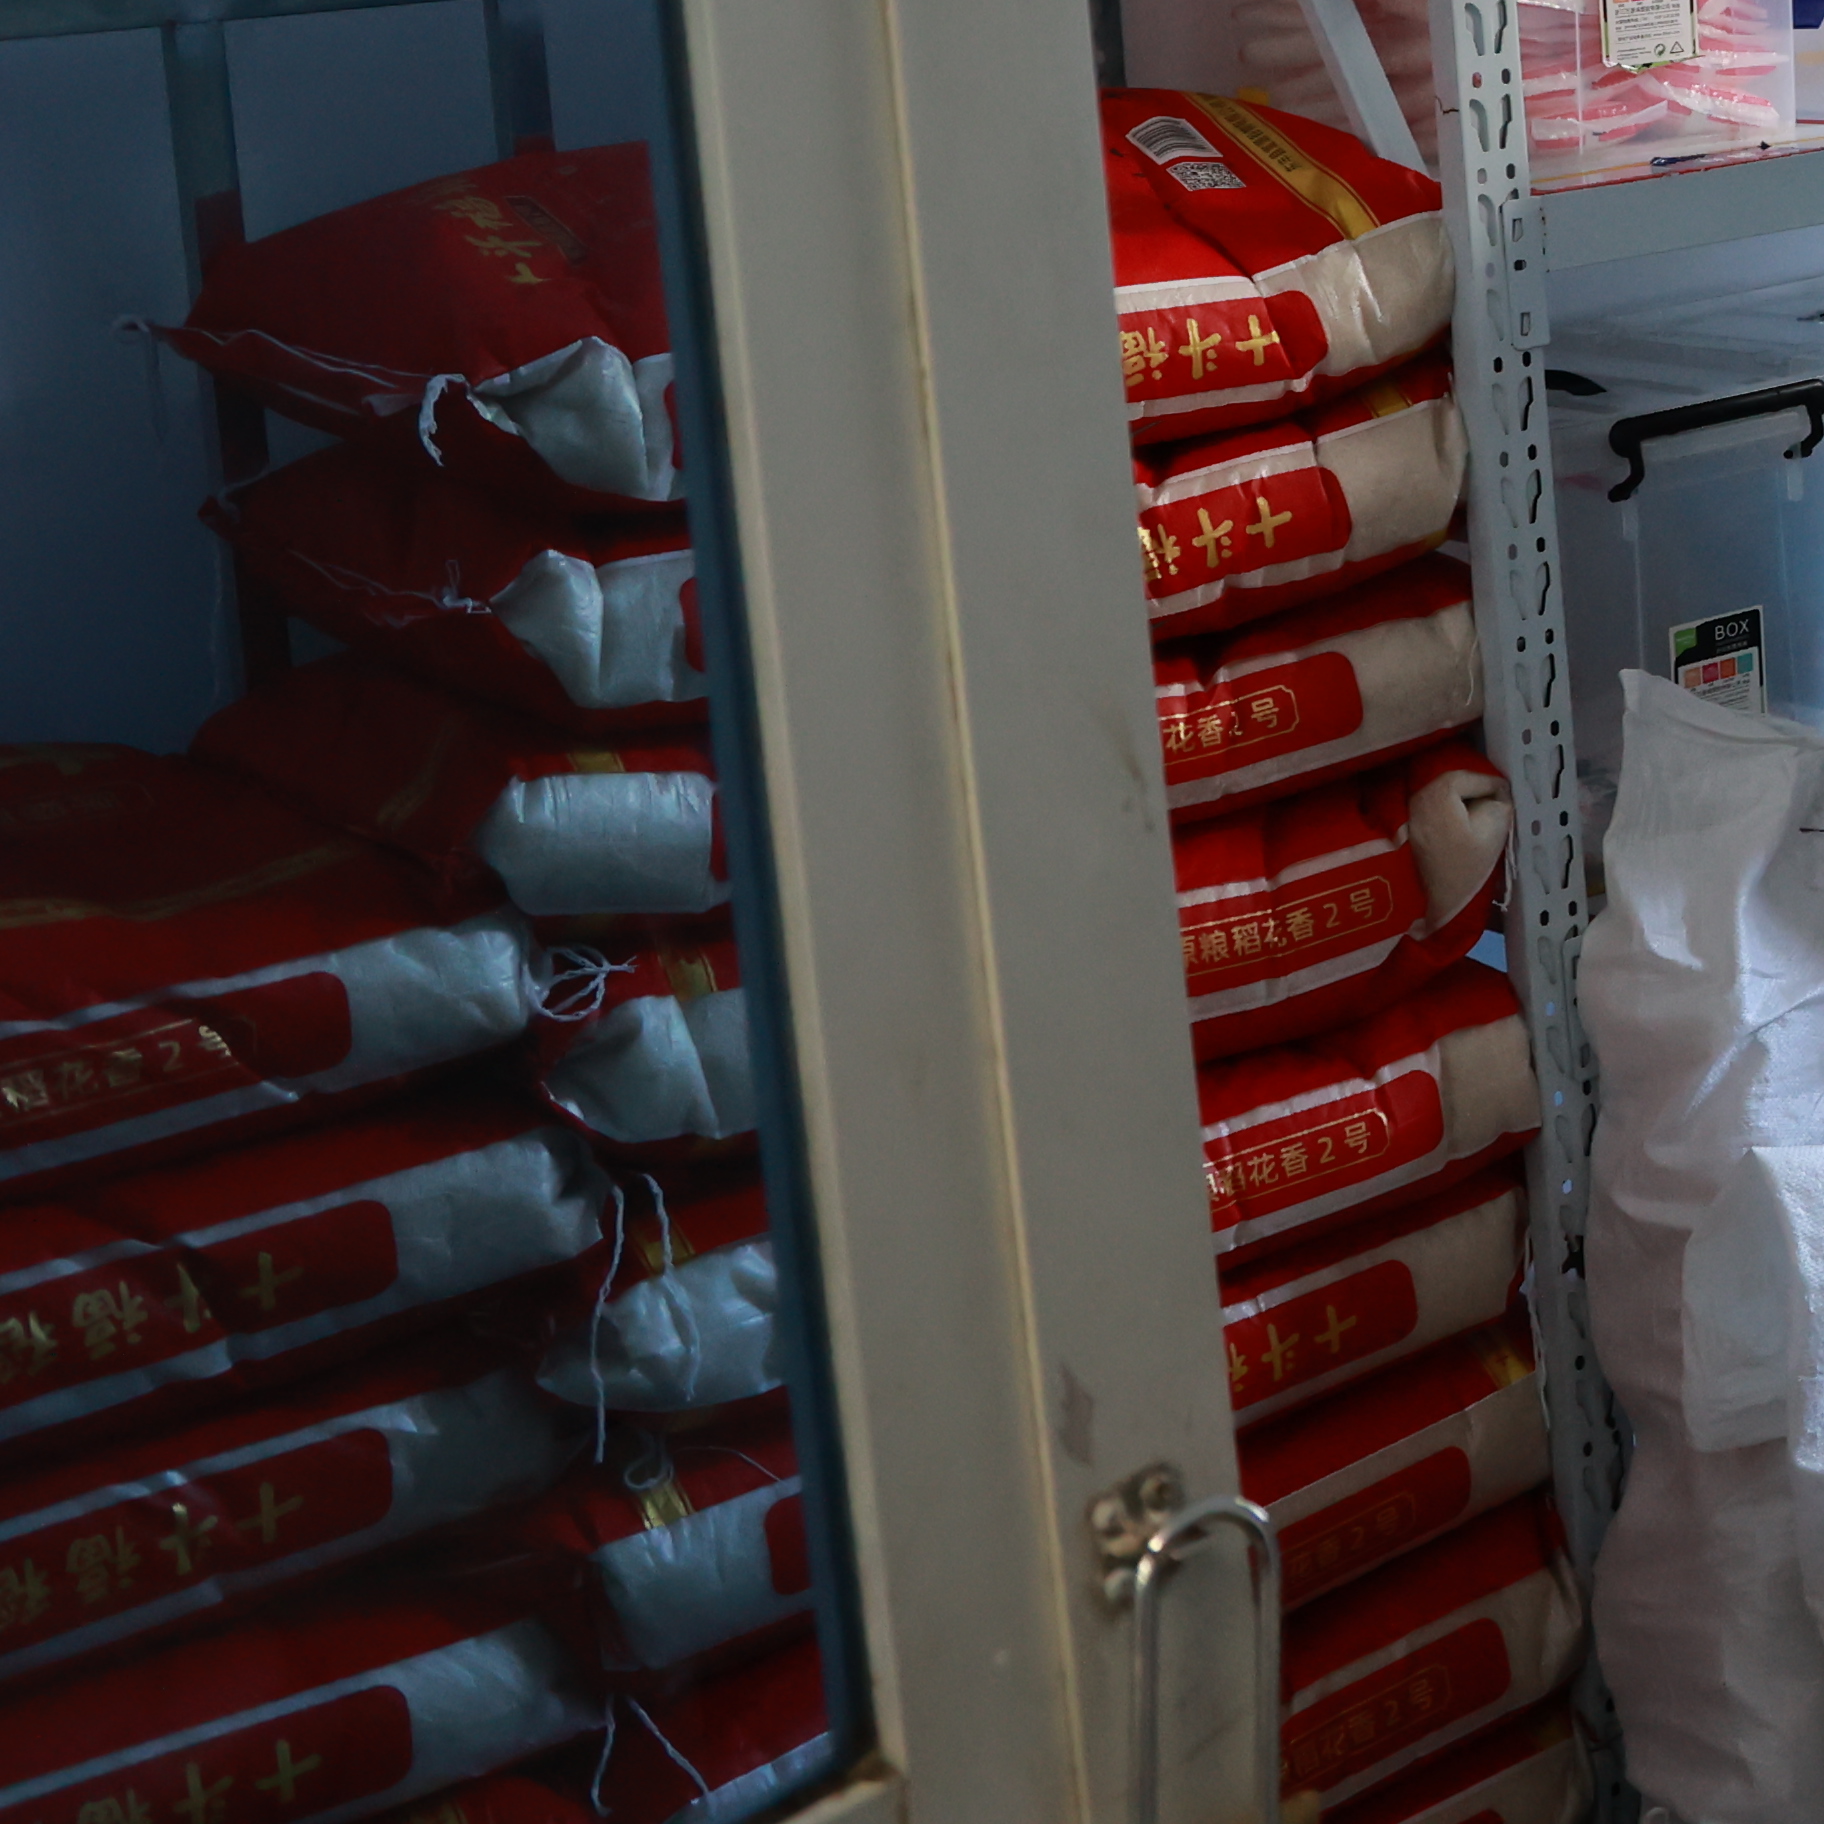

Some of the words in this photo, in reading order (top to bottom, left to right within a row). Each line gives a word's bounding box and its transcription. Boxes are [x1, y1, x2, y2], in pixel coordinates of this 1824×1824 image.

[1119, 314, 1280, 387] 十斗福
[1714, 619, 1750, 641] BOX
